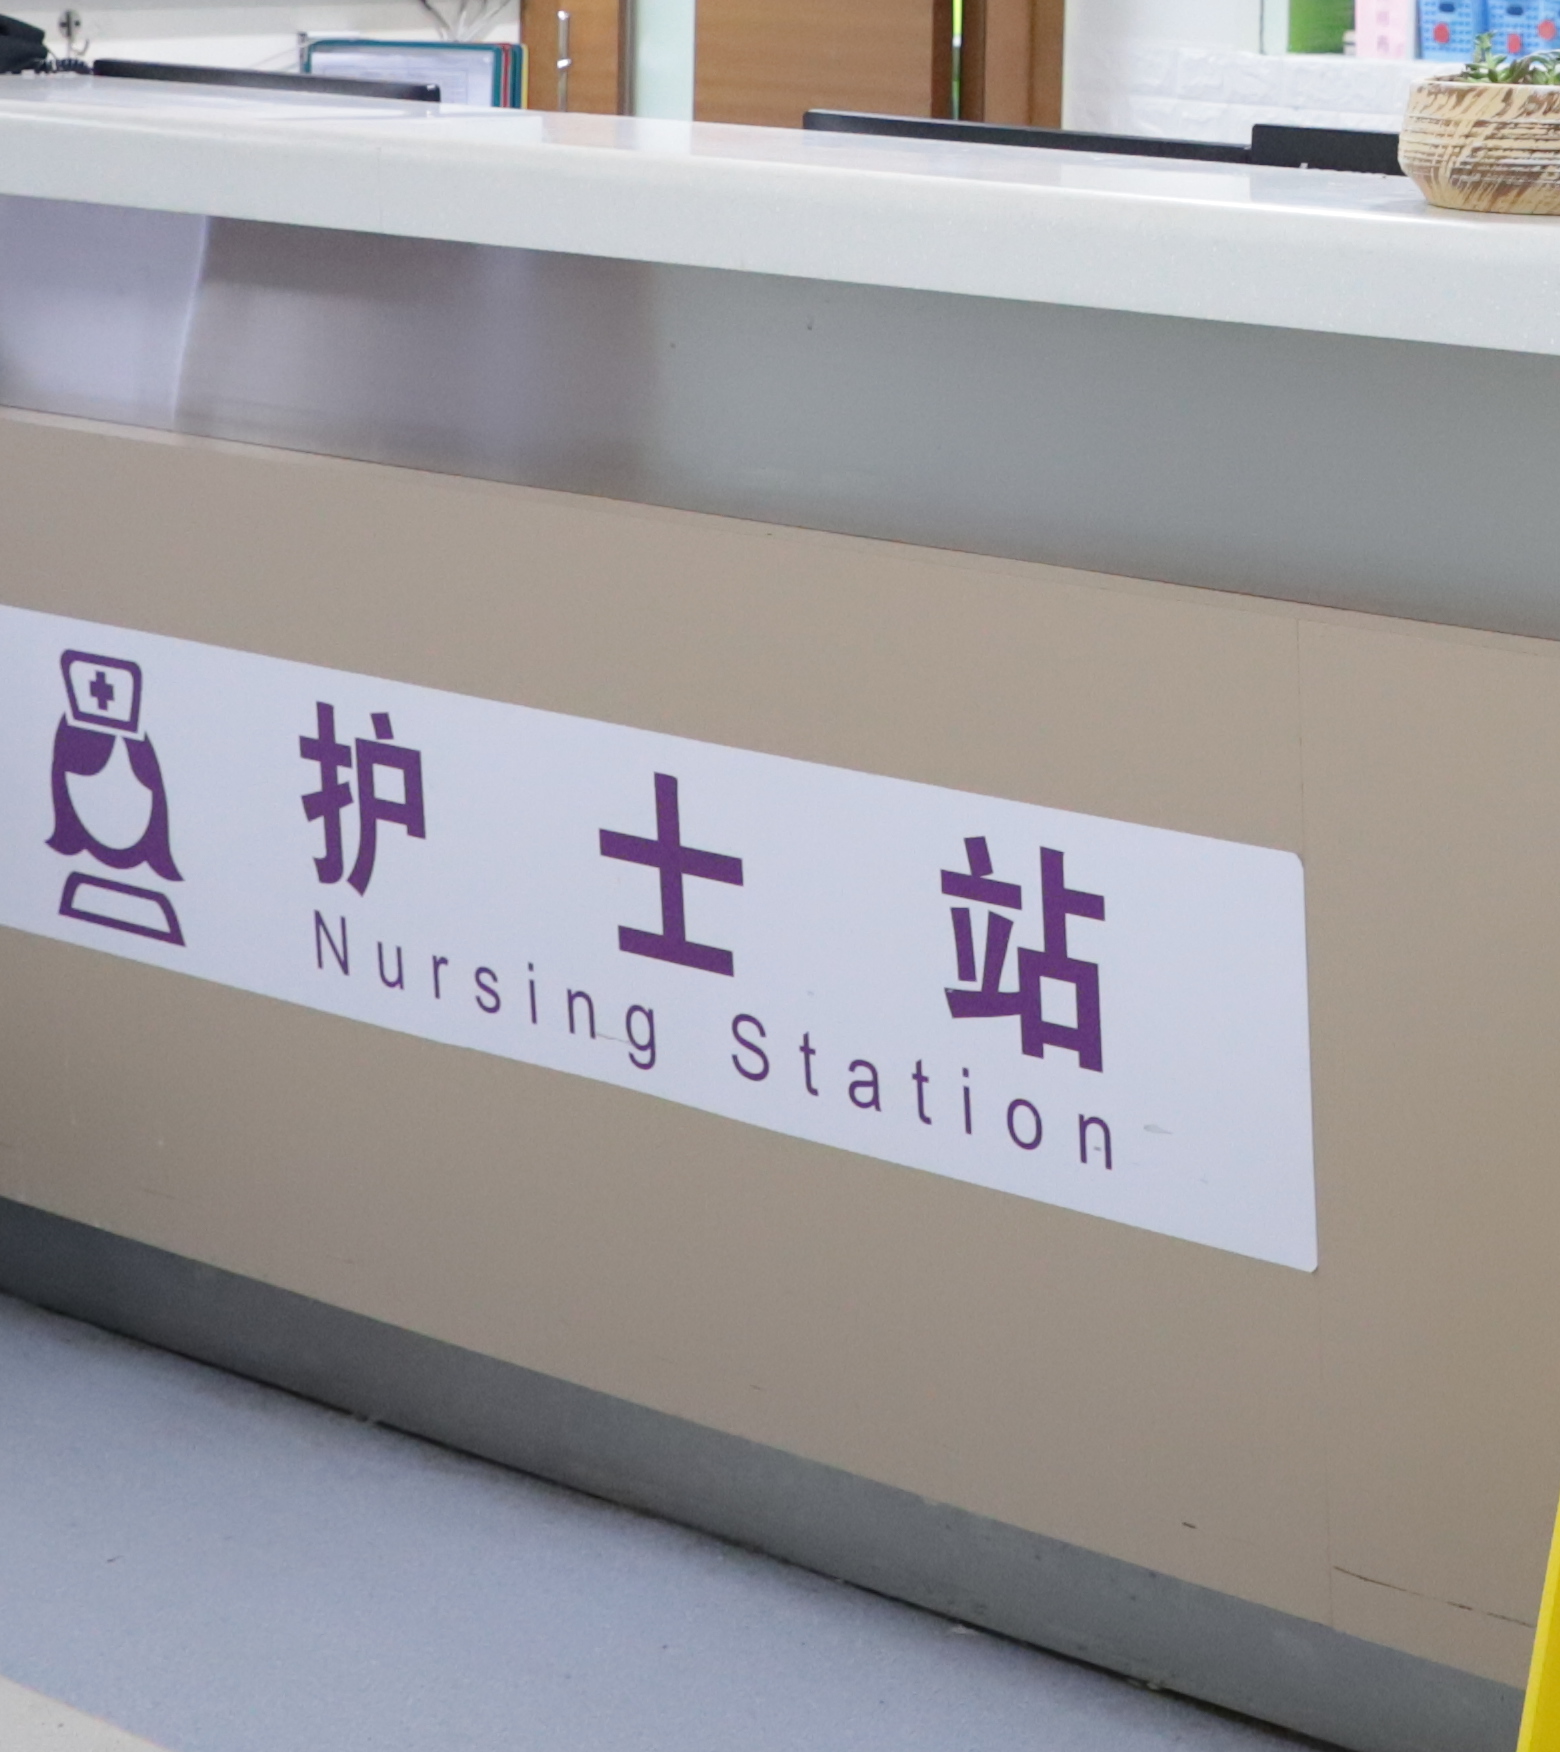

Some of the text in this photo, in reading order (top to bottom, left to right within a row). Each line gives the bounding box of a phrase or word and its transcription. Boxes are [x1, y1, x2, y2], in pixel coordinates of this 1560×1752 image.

[298, 700, 1107, 1073] 护士站
[313, 909, 1115, 1171] Nursing Station
